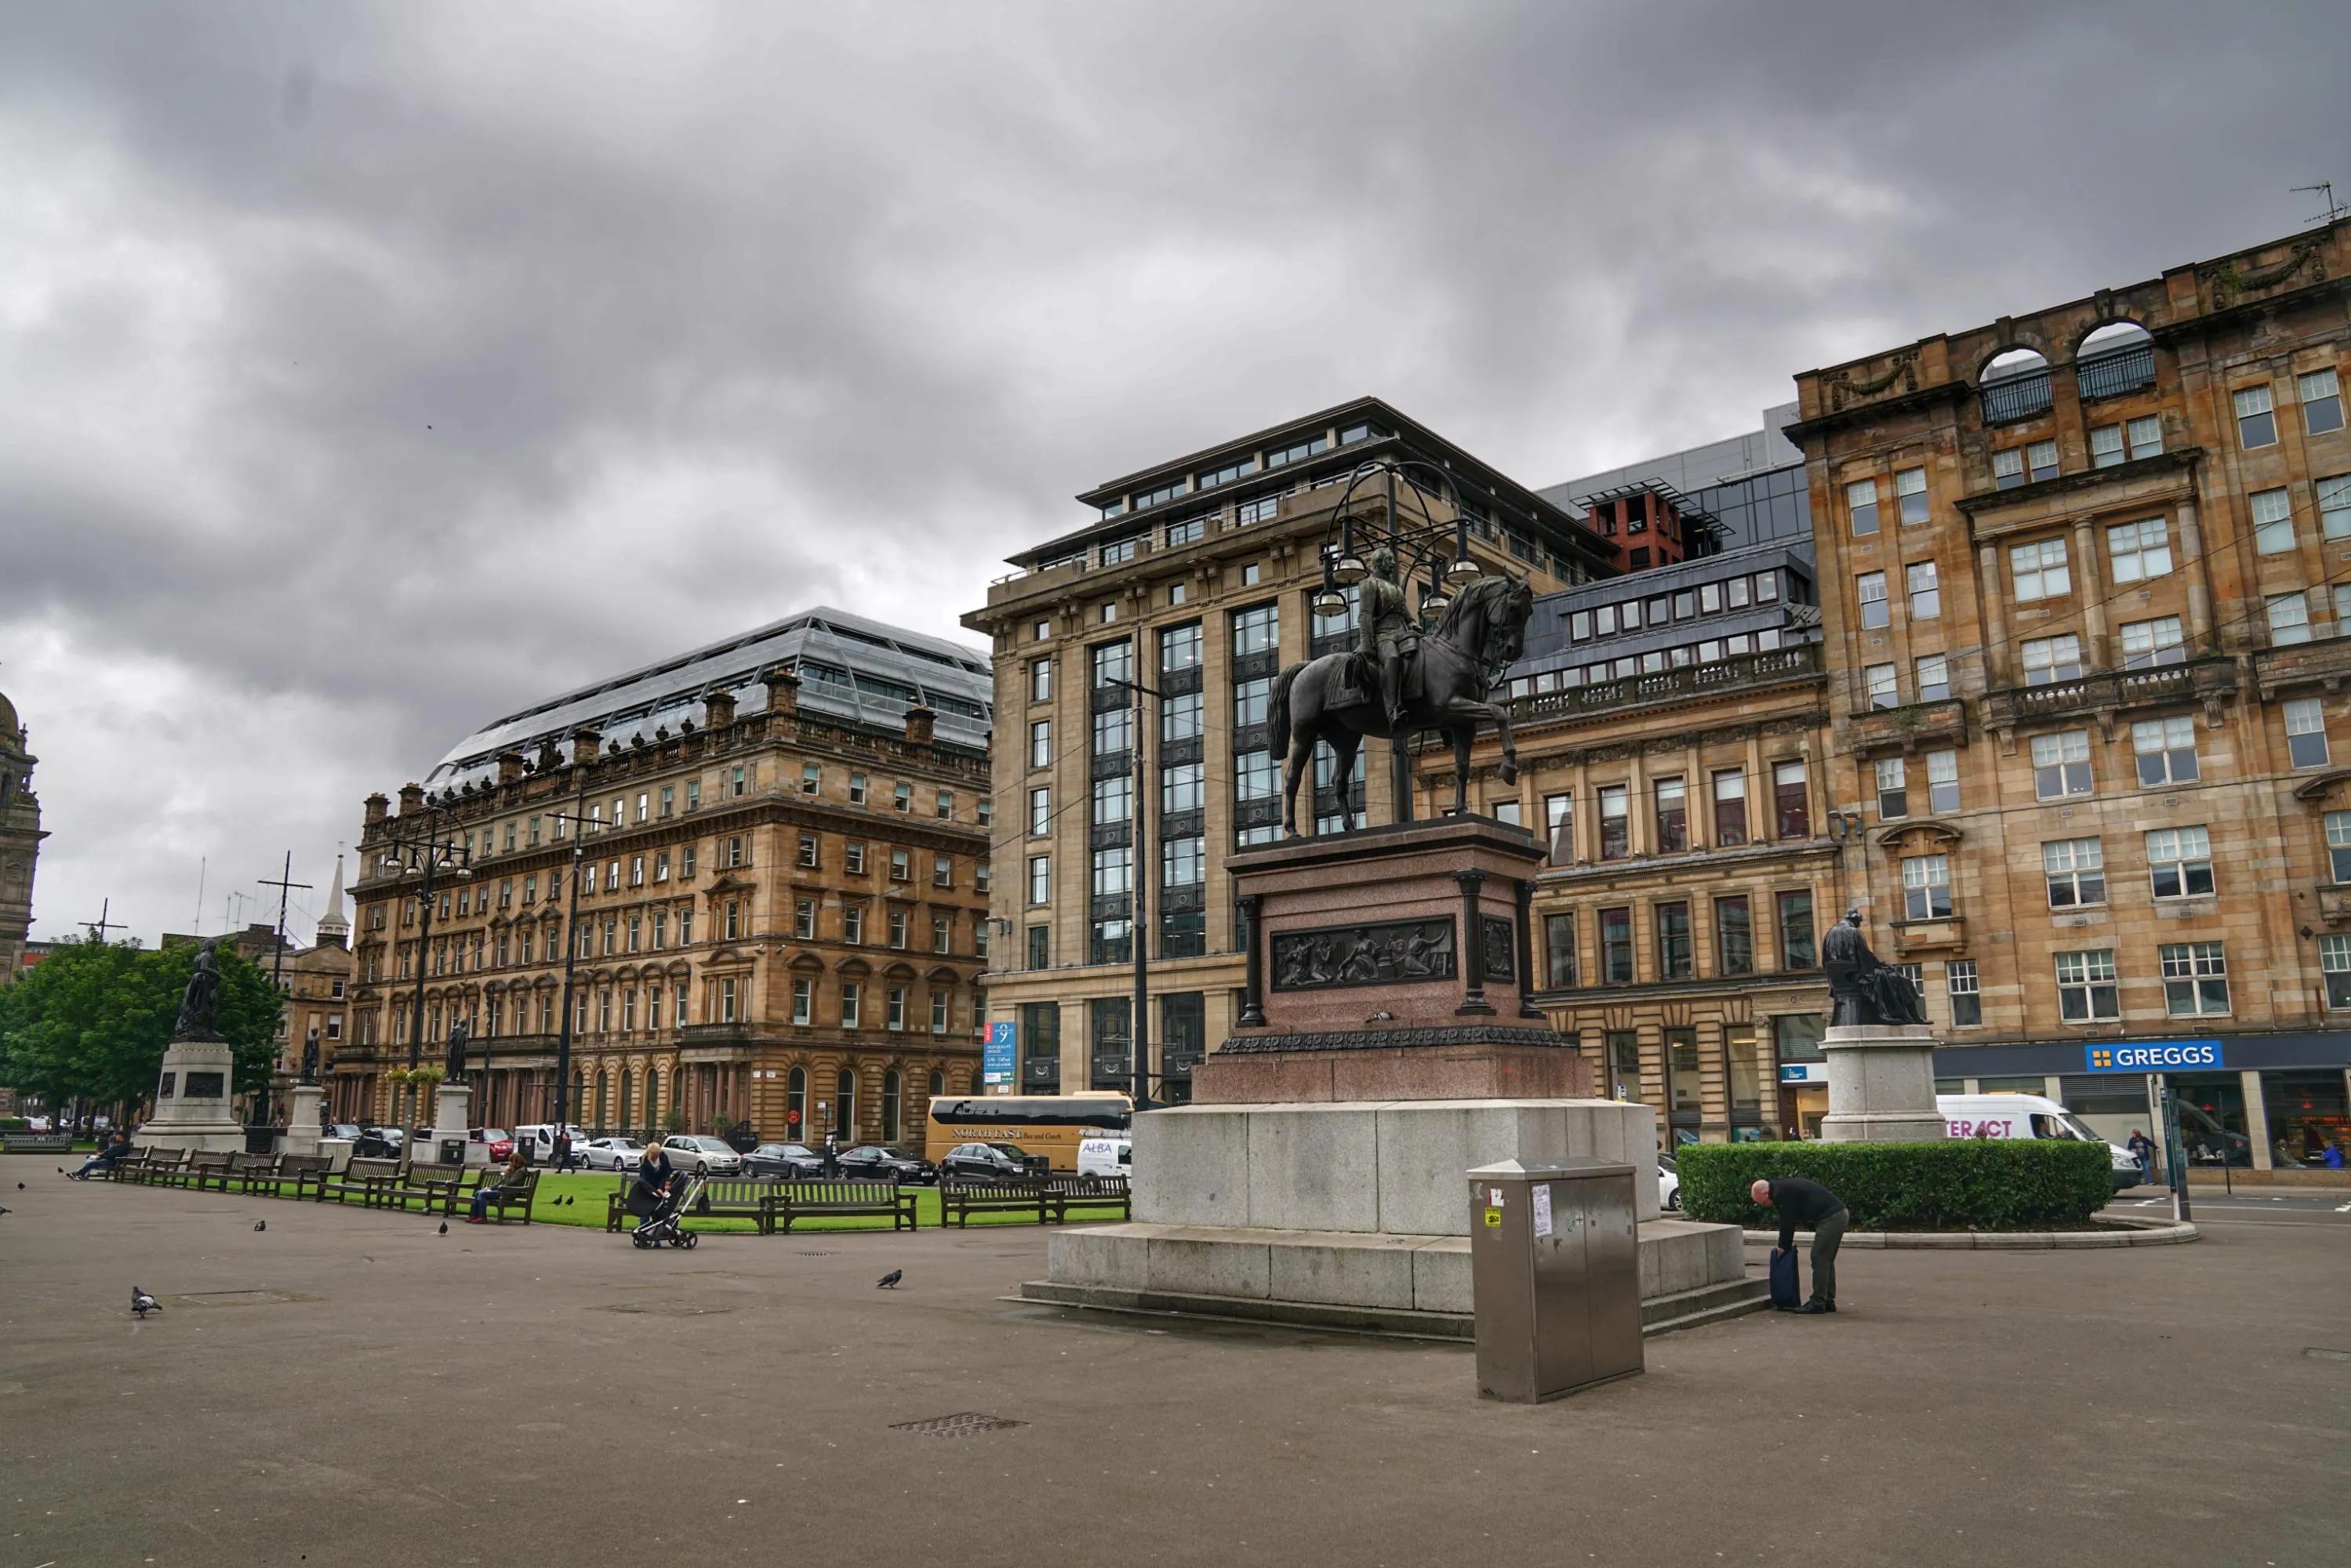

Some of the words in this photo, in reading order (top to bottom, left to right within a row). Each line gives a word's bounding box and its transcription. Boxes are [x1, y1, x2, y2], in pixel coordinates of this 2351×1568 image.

[2116, 1046, 2215, 1066] GREGGS
[952, 1128, 991, 1139] NORTH
[994, 1128, 1023, 1140] EAST
[1946, 1120, 2012, 1137] ERACT
[1083, 1142, 1112, 1154] ALBA
